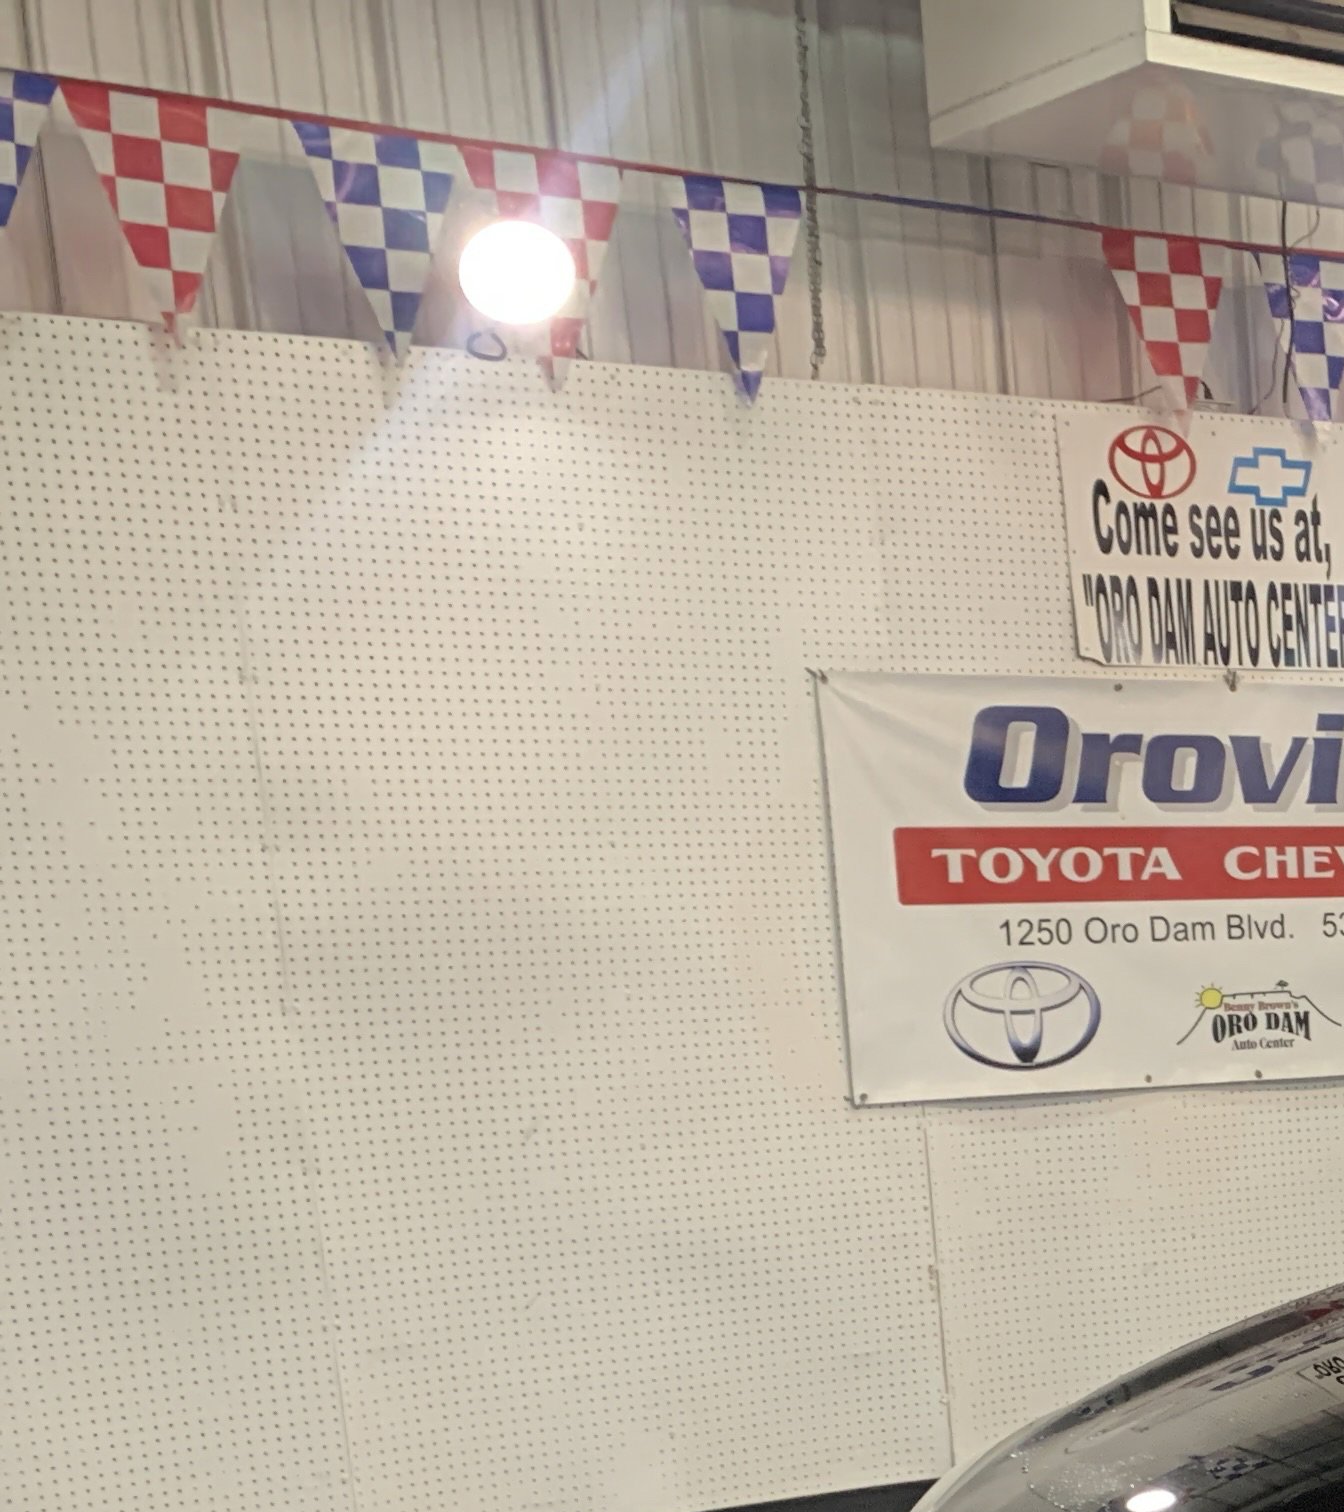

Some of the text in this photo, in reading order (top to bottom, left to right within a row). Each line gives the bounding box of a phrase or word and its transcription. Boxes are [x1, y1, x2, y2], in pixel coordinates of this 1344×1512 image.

[1092, 479, 1331, 580] Come see us at,
[1082, 573, 1142, 665] "ORO
[1147, 576, 1197, 665] DAM
[1204, 579, 1260, 667] AUTO
[931, 846, 1182, 883] TOYOTA
[1000, 917, 1072, 947] 1250
[1084, 917, 1140, 945] Oro
[1150, 915, 1216, 943] Dam
[1226, 913, 1294, 941] Blvd.
[1212, 1011, 1312, 1043] ORO DAM
[1231, 1037, 1295, 1050] Auto Center
